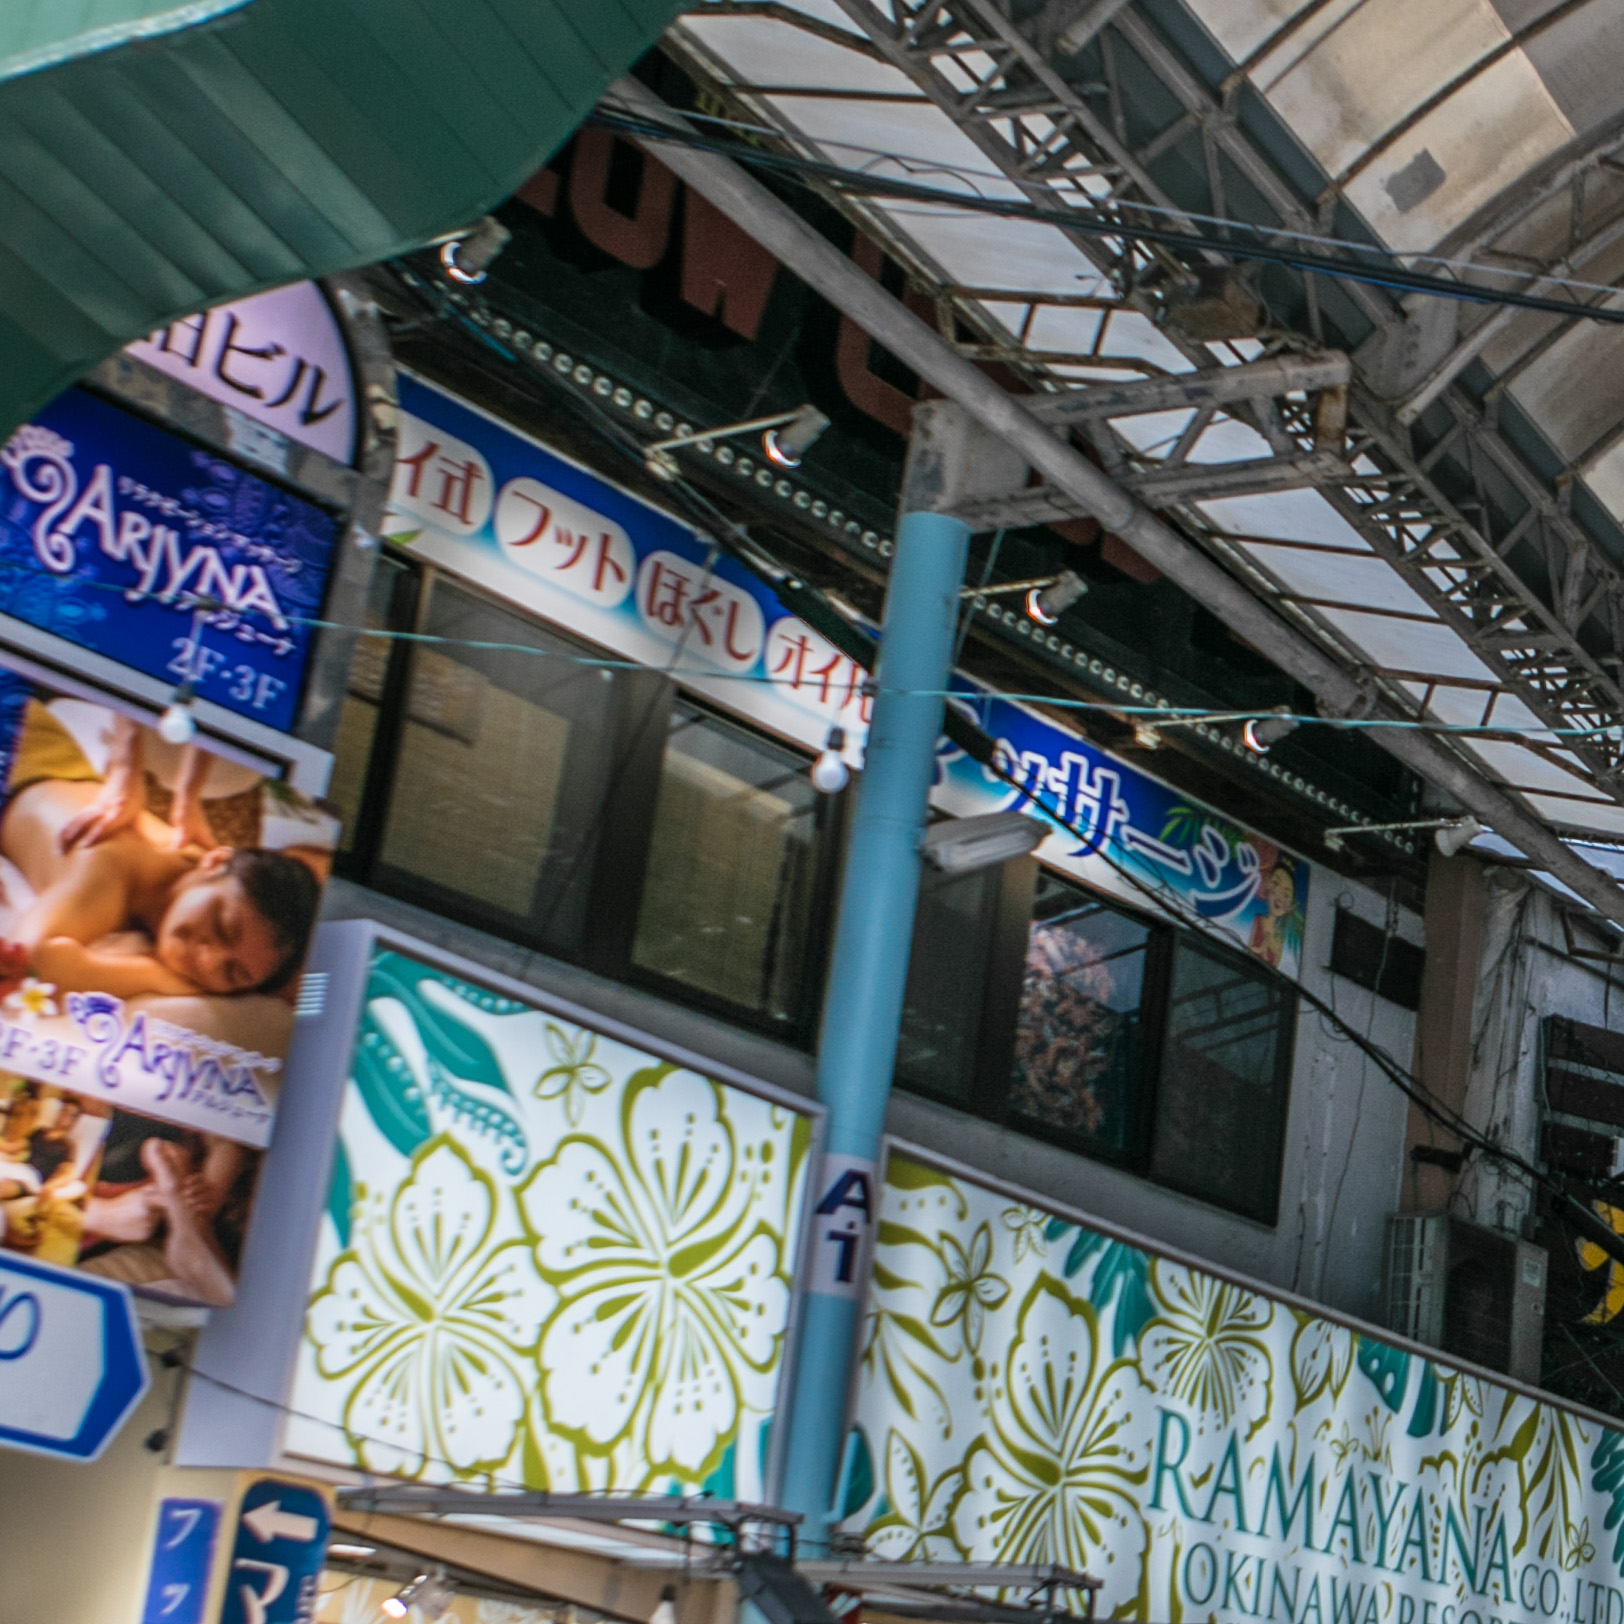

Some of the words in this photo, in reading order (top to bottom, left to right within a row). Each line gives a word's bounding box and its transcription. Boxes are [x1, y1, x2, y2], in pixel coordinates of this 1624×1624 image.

[508, 487, 628, 594] フット
[643, 558, 761, 661] ほぐし
[1148, 1405, 1516, 1607] RAMAYANA
